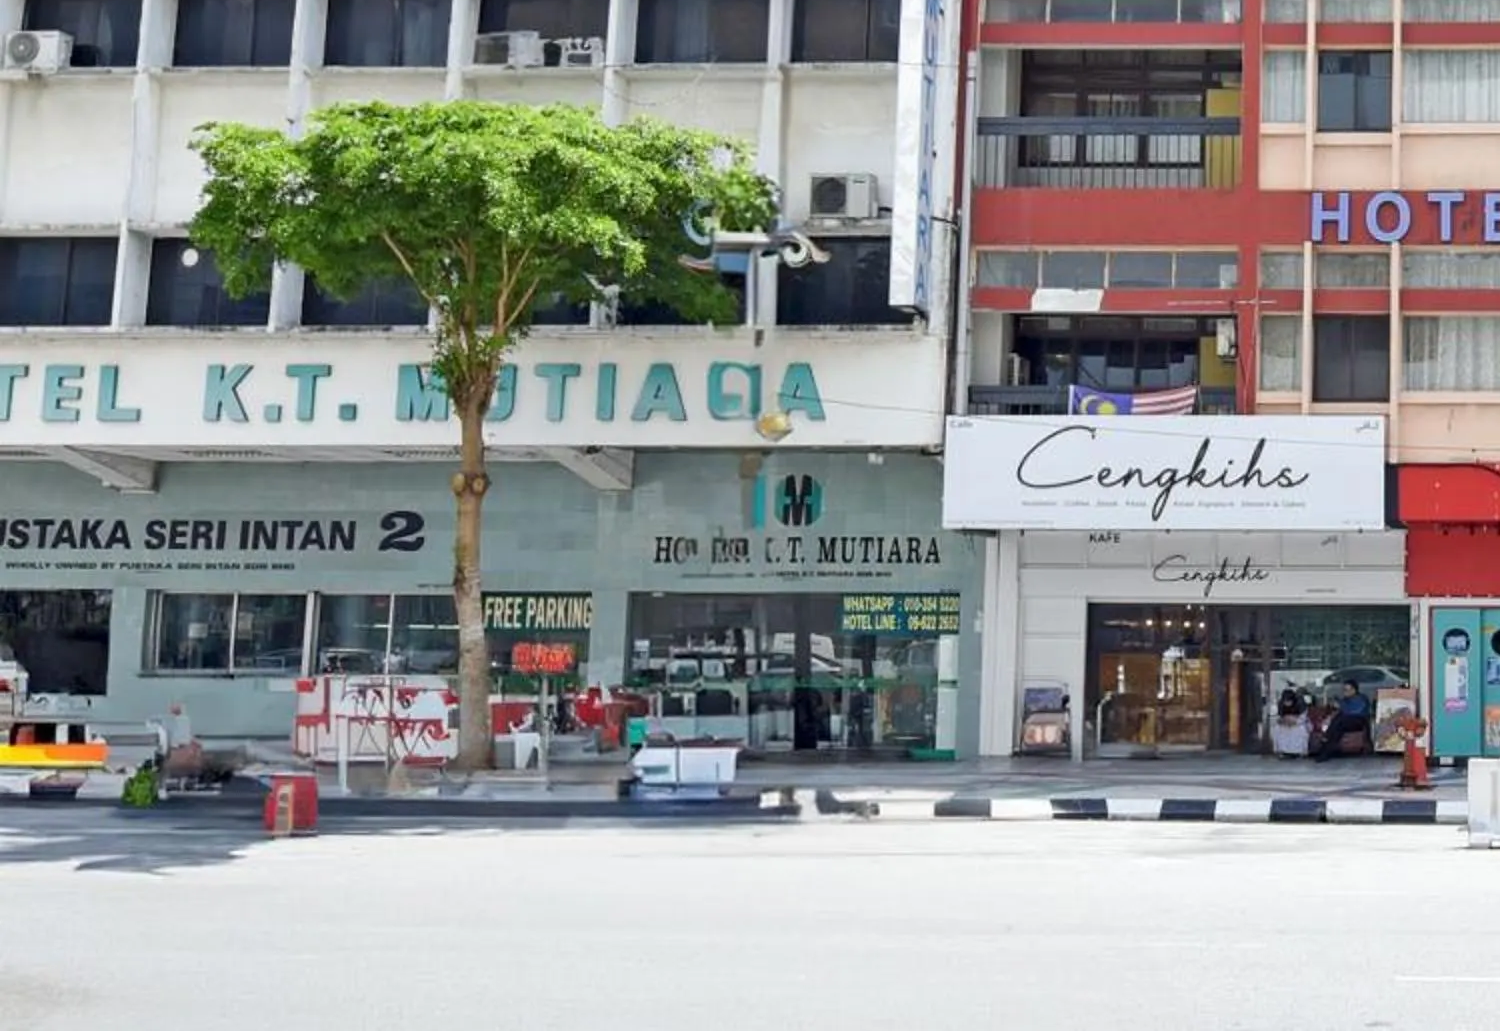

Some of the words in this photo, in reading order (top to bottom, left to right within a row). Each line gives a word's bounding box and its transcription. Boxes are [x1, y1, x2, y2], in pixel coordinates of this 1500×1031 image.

[1016, 424, 1310, 521] Cengkihs
[0, 519, 132, 551] STAKA
[143, 520, 226, 551] SERI
[239, 520, 357, 552] INTAN
[378, 510, 425, 552] 2
[1089, 532, 1121, 544] KAFE
[817, 536, 941, 564] MUTIARA
[1152, 554, 1270, 597] Cengkihs
[484, 596, 523, 629] FREE
[525, 596, 593, 629] PARKING
[842, 614, 873, 630] HOTEL
